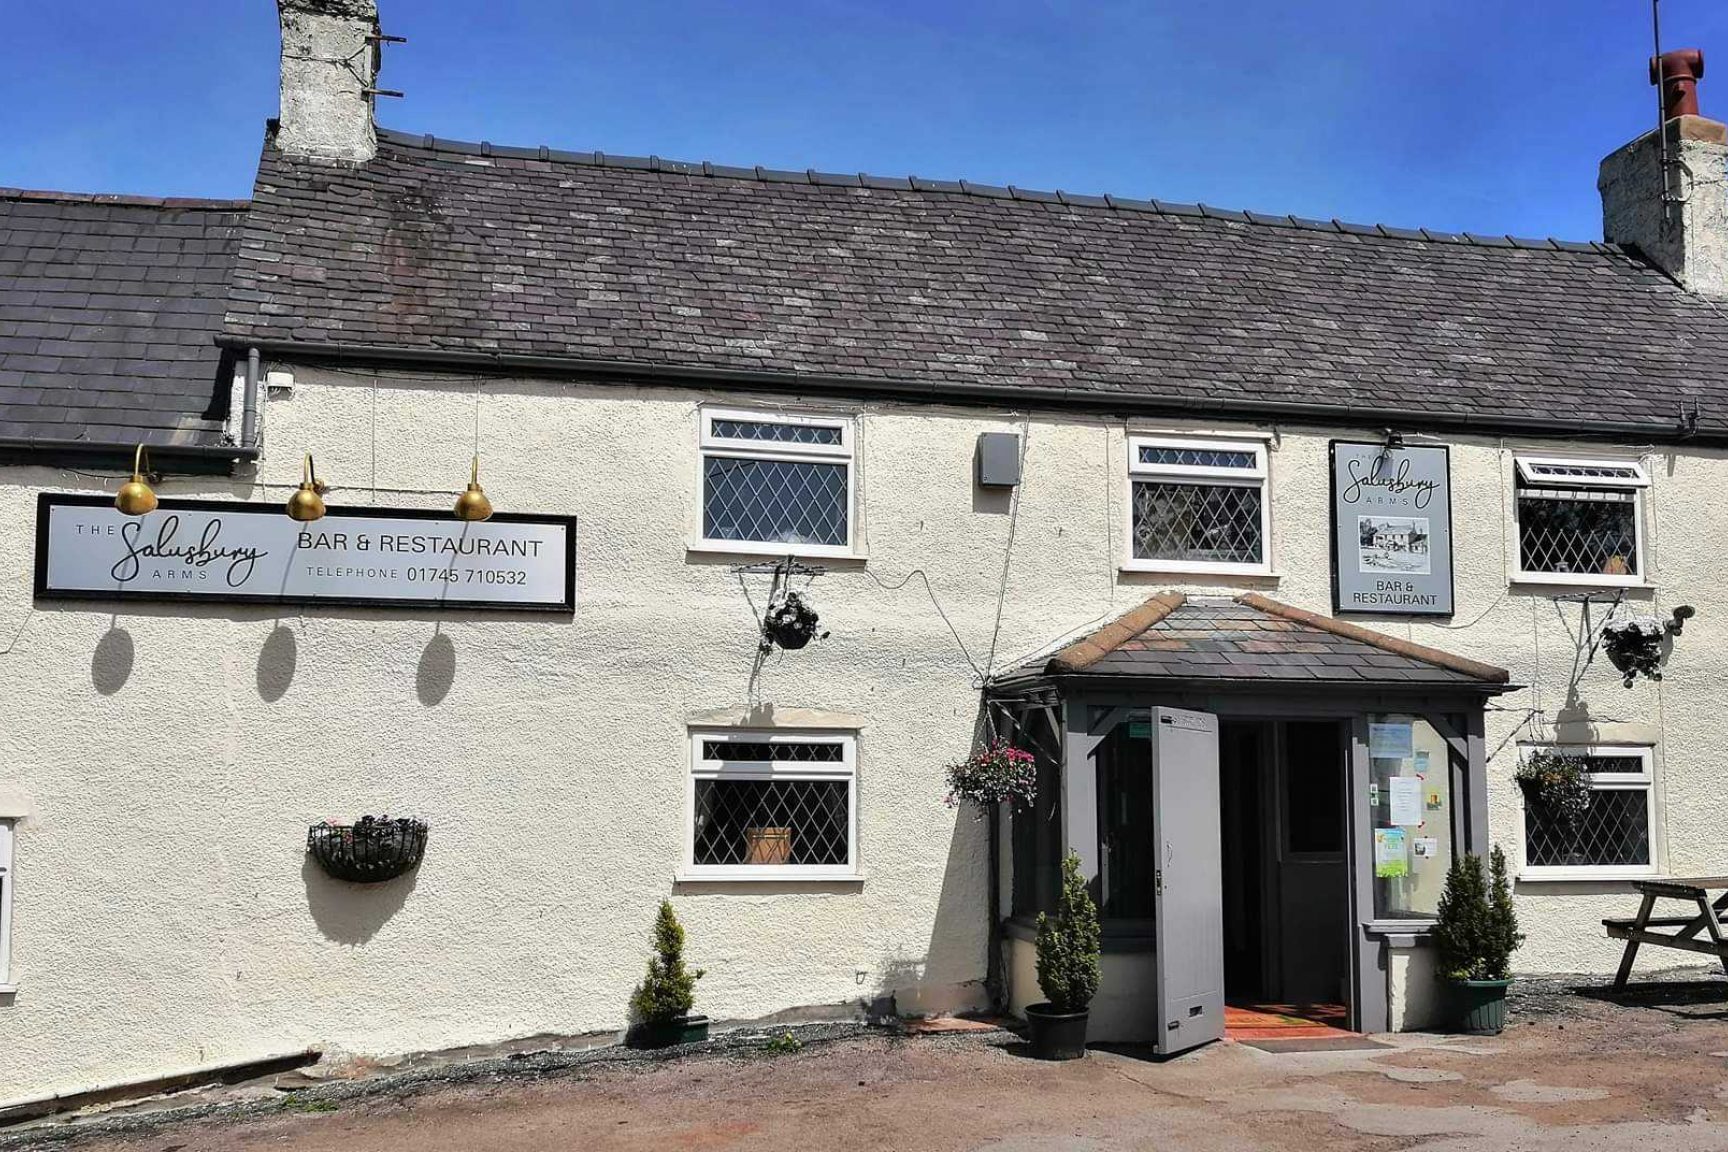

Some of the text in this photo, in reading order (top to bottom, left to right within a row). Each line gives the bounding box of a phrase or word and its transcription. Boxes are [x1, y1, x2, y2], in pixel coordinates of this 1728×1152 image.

[1343, 456, 1440, 509] Salusbury
[76, 515, 268, 587] THE Salusbury
[297, 532, 543, 557] BAR & RESTAURANT
[152, 569, 208, 580] ARMS
[307, 566, 527, 585] TELEPHONE 01745 710532
[1376, 580, 1414, 592] BAR &
[1353, 592, 1438, 606] RESTAURANT
